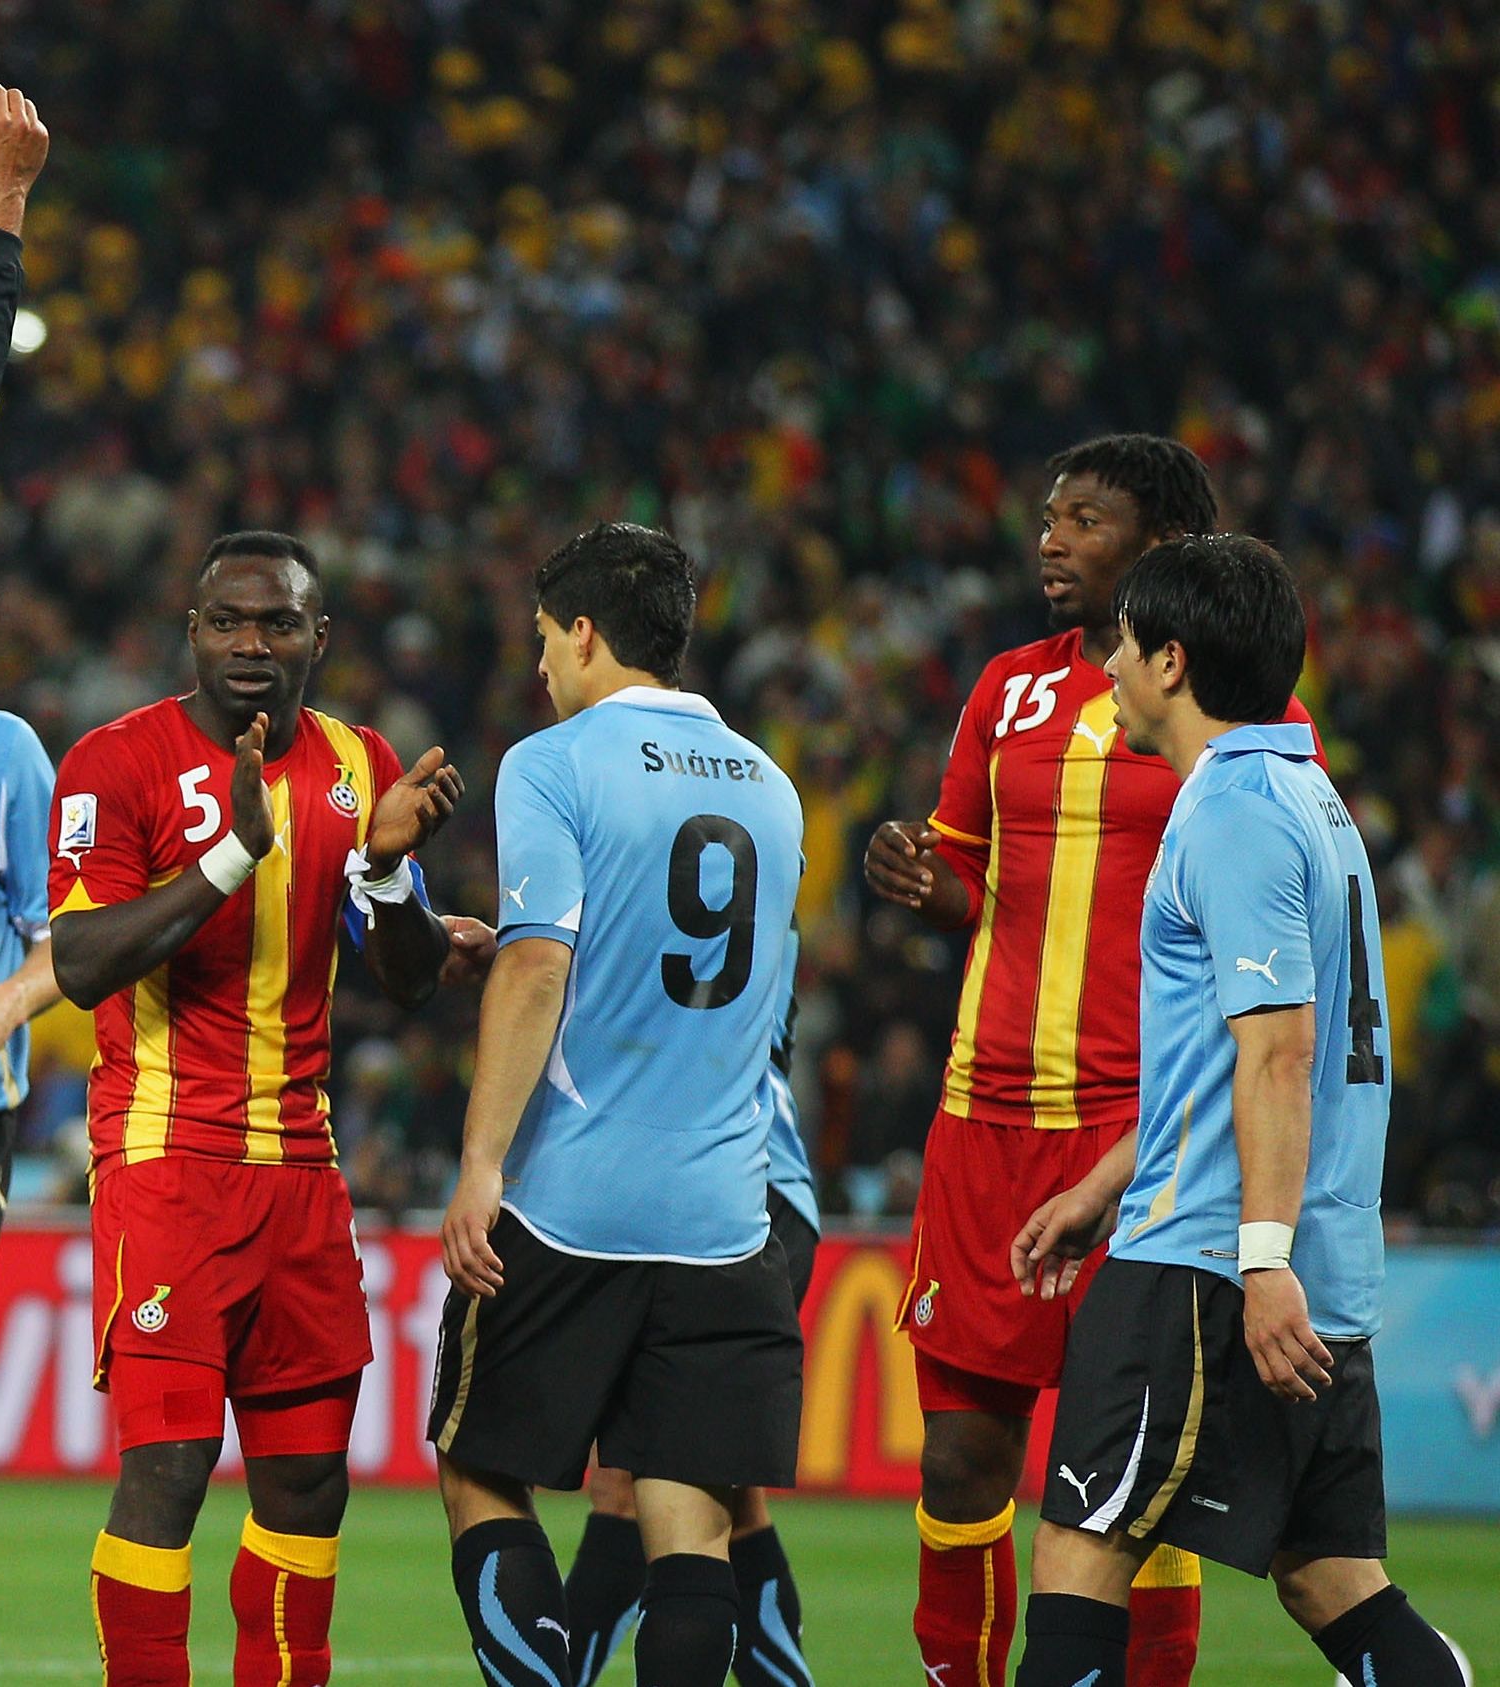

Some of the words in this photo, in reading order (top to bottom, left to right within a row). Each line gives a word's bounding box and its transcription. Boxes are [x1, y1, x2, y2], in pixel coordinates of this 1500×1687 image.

[995, 666, 1071, 738] 15
[641, 742, 764, 783] Suárez
[178, 765, 221, 843] 5
[661, 814, 757, 1009] 9
